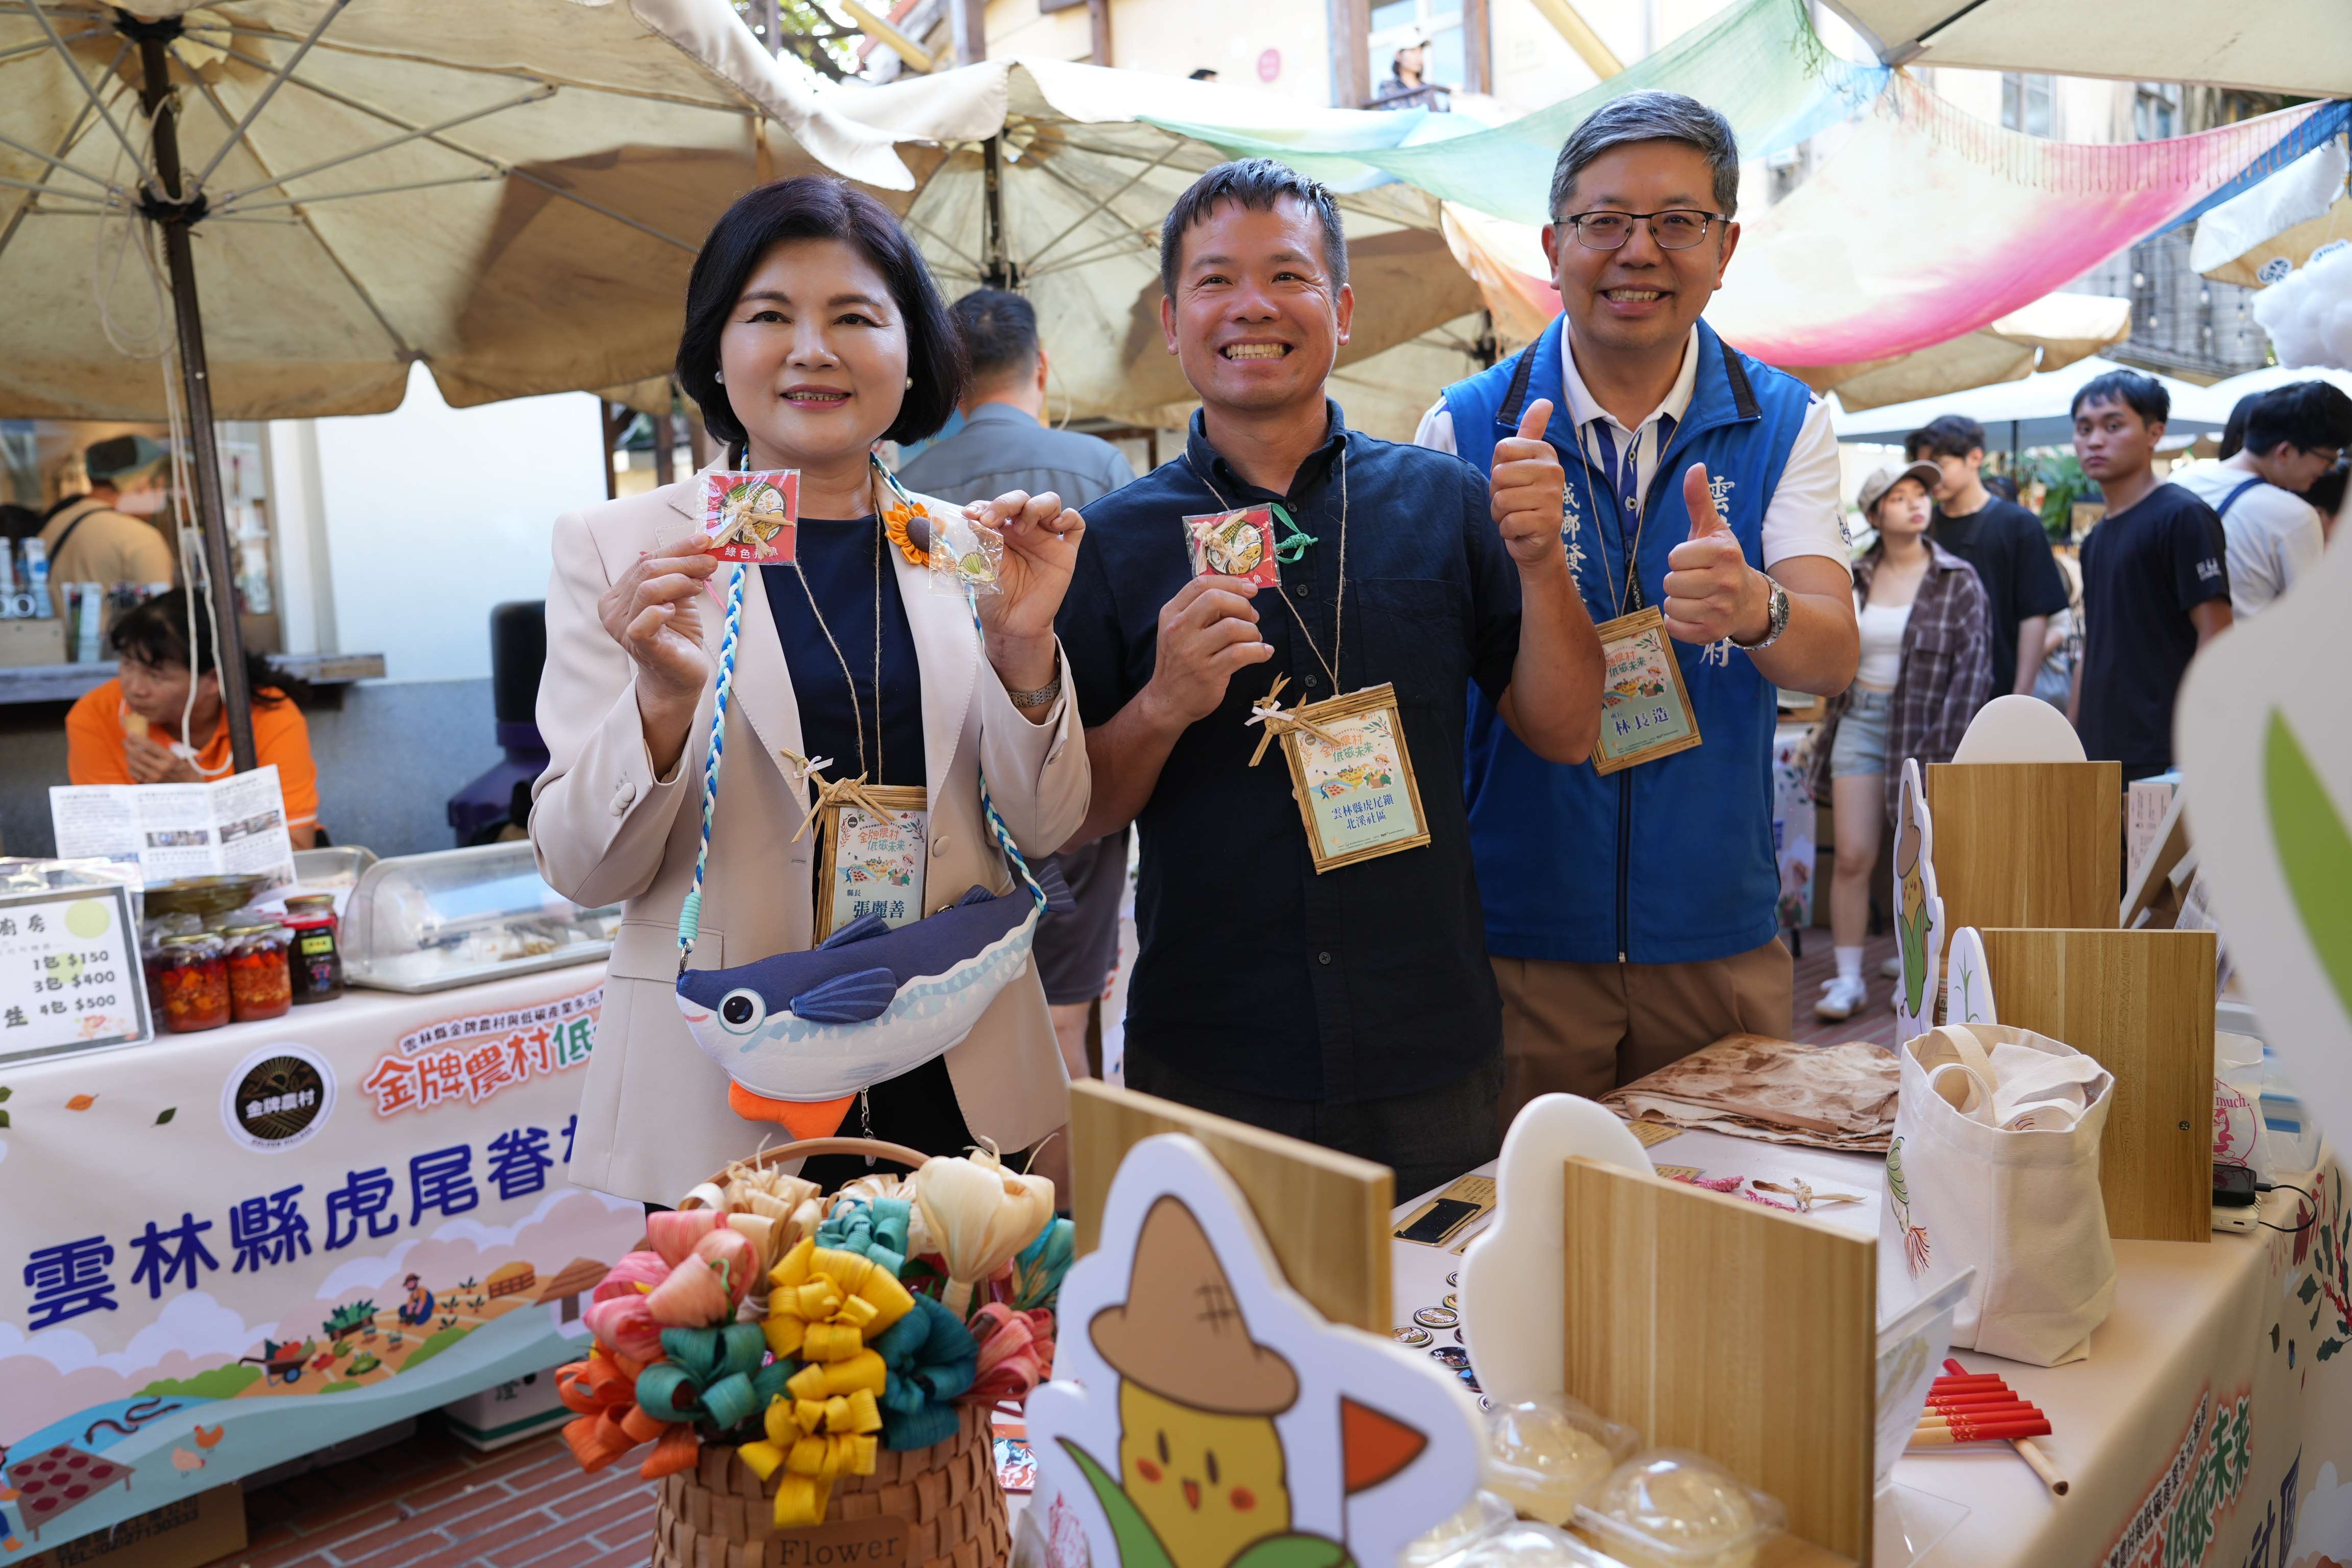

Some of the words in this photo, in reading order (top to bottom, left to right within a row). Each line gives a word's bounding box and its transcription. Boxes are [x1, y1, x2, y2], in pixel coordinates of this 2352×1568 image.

[1331, 793, 1394, 820] 雲林縣虎尾鎮
[1347, 809, 1387, 830] 北溪社區
[858, 827, 899, 844] 金牌農村
[853, 900, 904, 918] 張麗善
[67, 950, 109, 967] $150
[71, 971, 115, 989] $400
[76, 995, 115, 1012] $500
[403, 987, 603, 1052] 雲林縣金牌農村與低碳產業多元
[366, 1018, 597, 1114] 金牌農村低
[2216, 1094, 2250, 1108] much.
[779, 1537, 898, 1566] Flower
